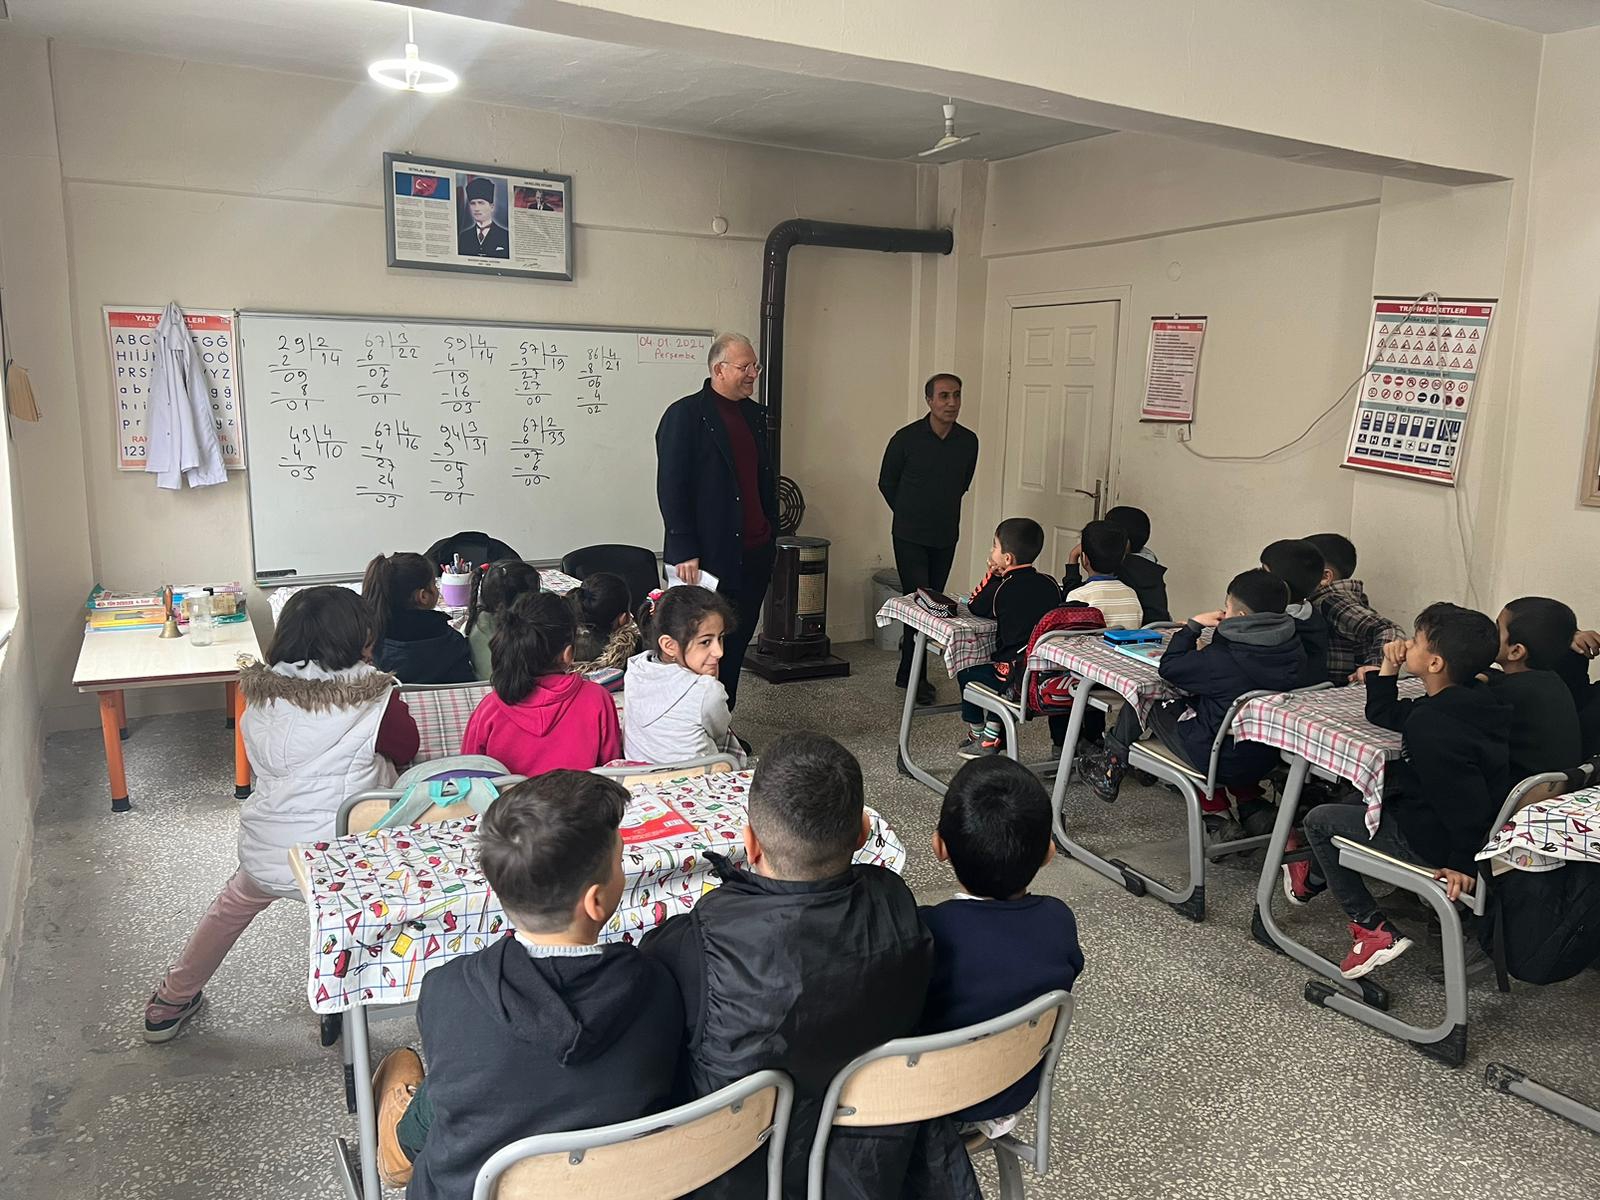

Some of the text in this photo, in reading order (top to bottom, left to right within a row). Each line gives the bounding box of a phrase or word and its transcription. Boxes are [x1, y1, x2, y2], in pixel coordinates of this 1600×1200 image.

[278, 336, 305, 354] 29
[365, 333, 385, 348] 67
[444, 337, 466, 350] 59
[520, 342, 539, 354] 57
[588, 348, 598, 360] 86
[375, 422, 390, 436] 67
[523, 417, 538, 432] 67
[290, 426, 311, 442] 43
